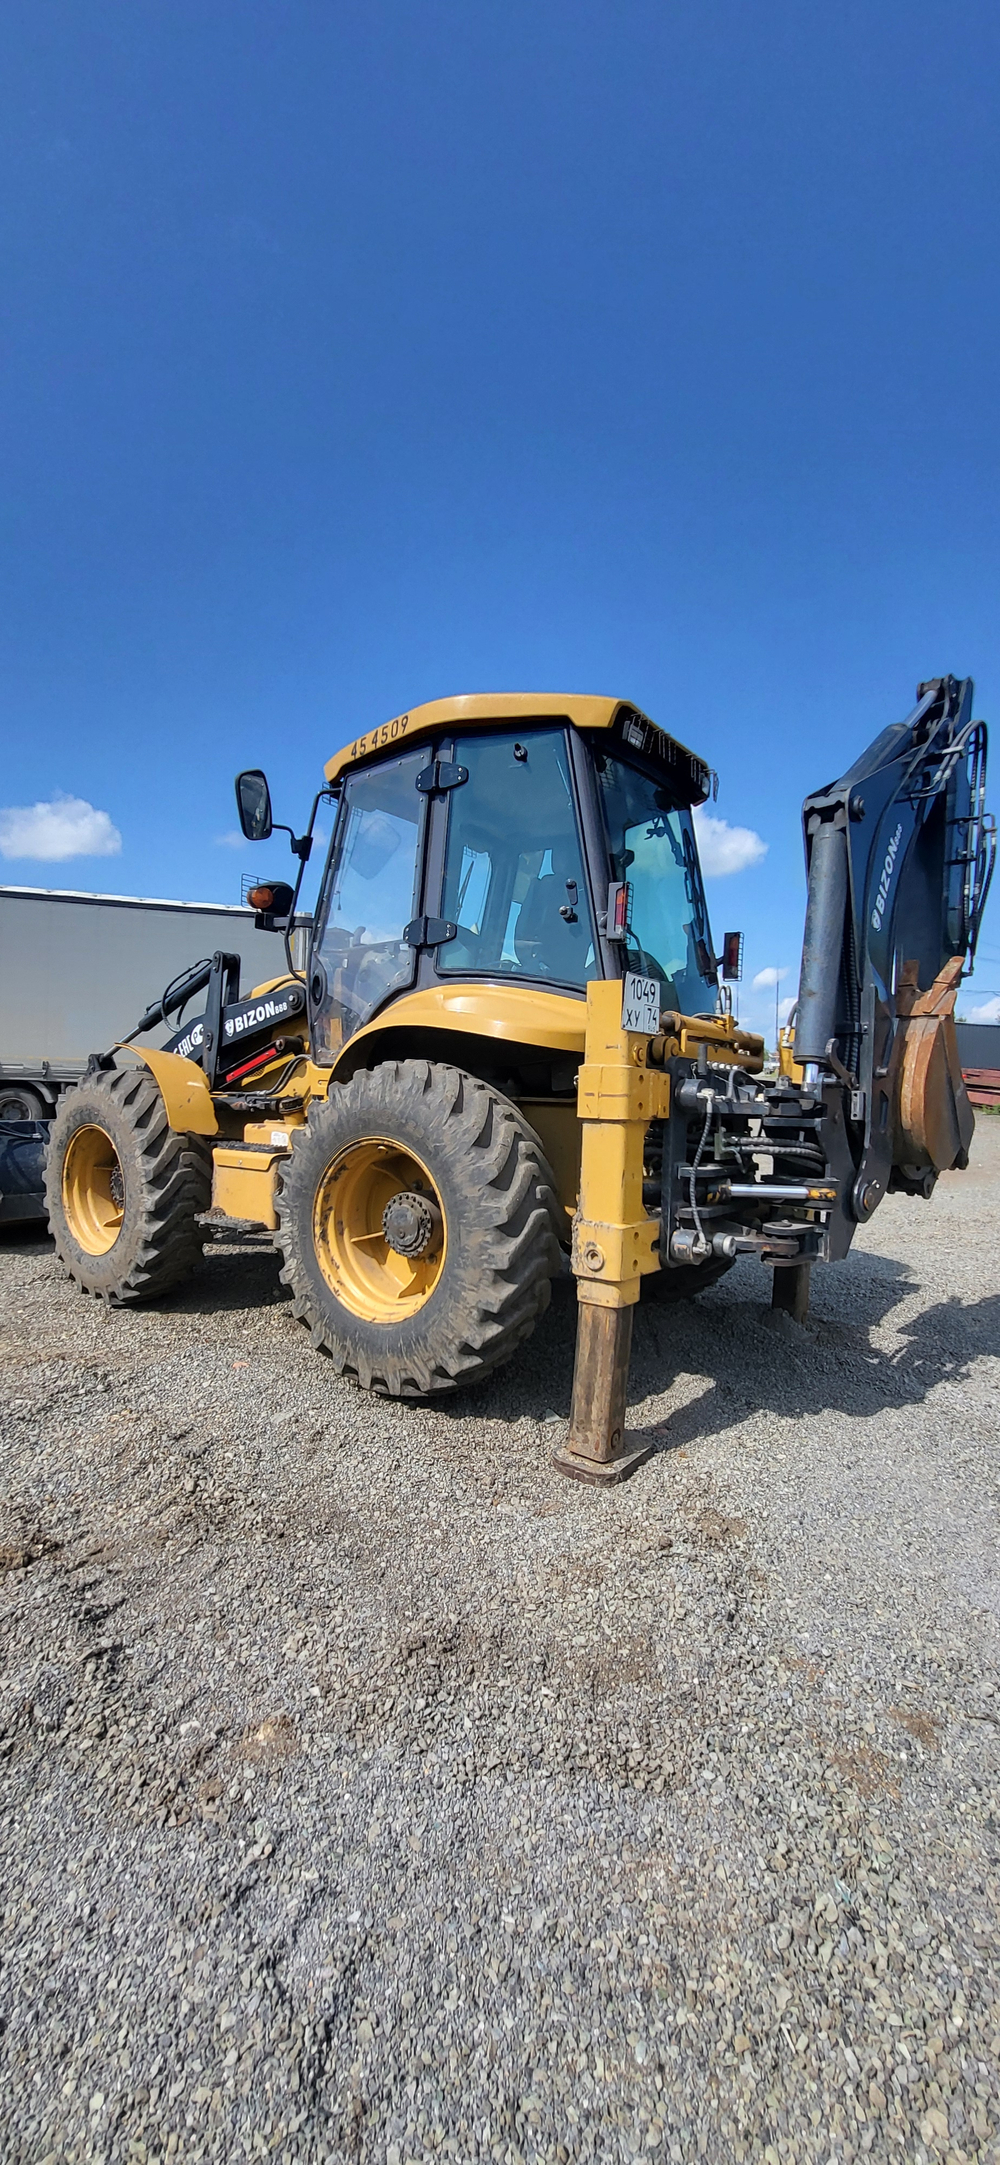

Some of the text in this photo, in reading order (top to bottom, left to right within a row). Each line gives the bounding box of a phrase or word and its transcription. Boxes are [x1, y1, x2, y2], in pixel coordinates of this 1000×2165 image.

[351, 715, 409, 760] 45 4509
[876, 837, 898, 915] BIZON
[631, 977, 656, 1004] 1049
[234, 1000, 288, 1033] BIZON 888
[647, 1008, 657, 1026] 74
